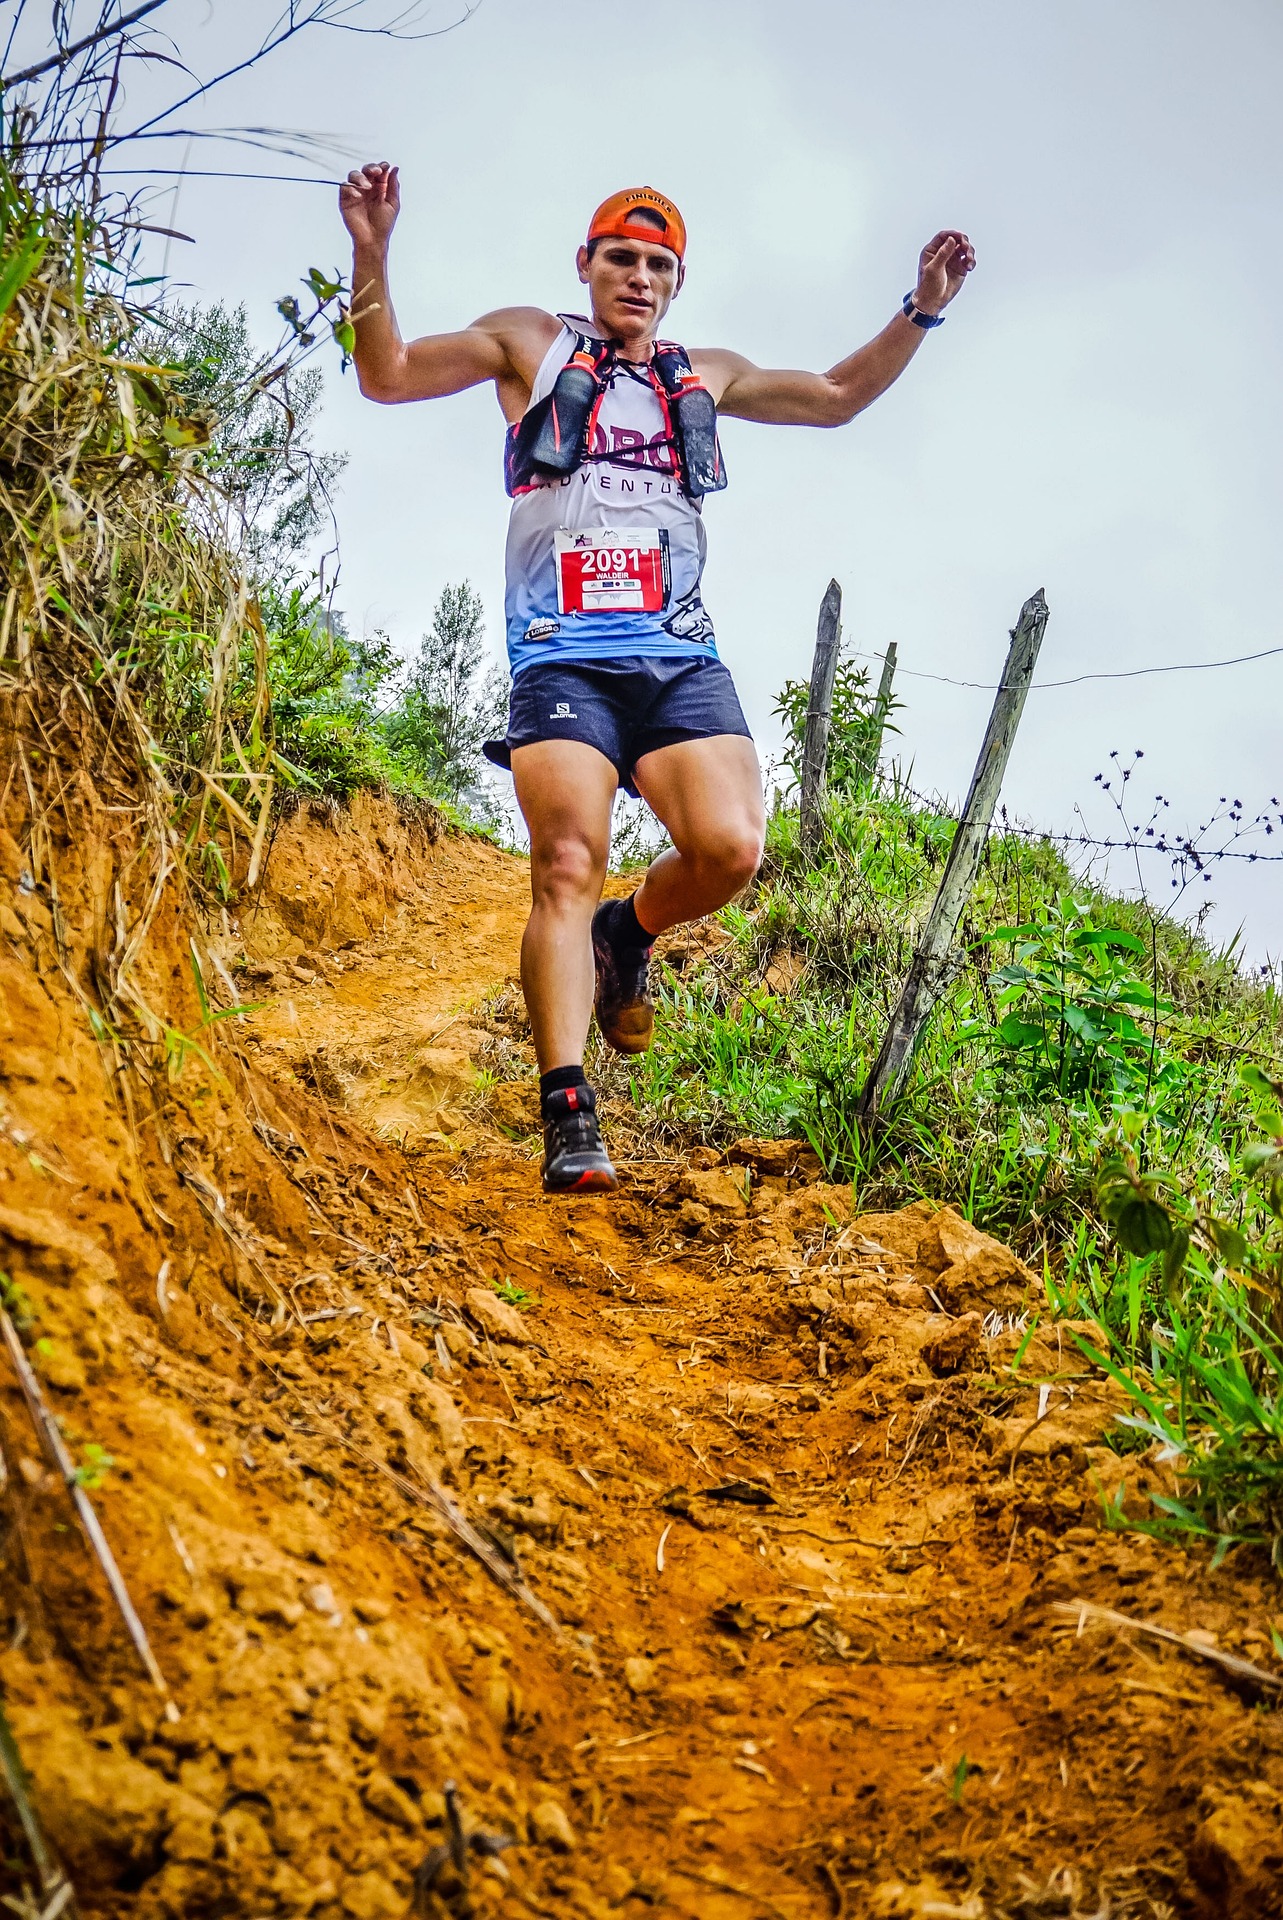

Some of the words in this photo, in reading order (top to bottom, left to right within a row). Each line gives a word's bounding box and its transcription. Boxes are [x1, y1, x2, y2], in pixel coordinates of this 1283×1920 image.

[625, 193, 672, 213] FINISHER
[580, 548, 640, 573] 2091
[596, 572, 629, 580] WALDEIR
